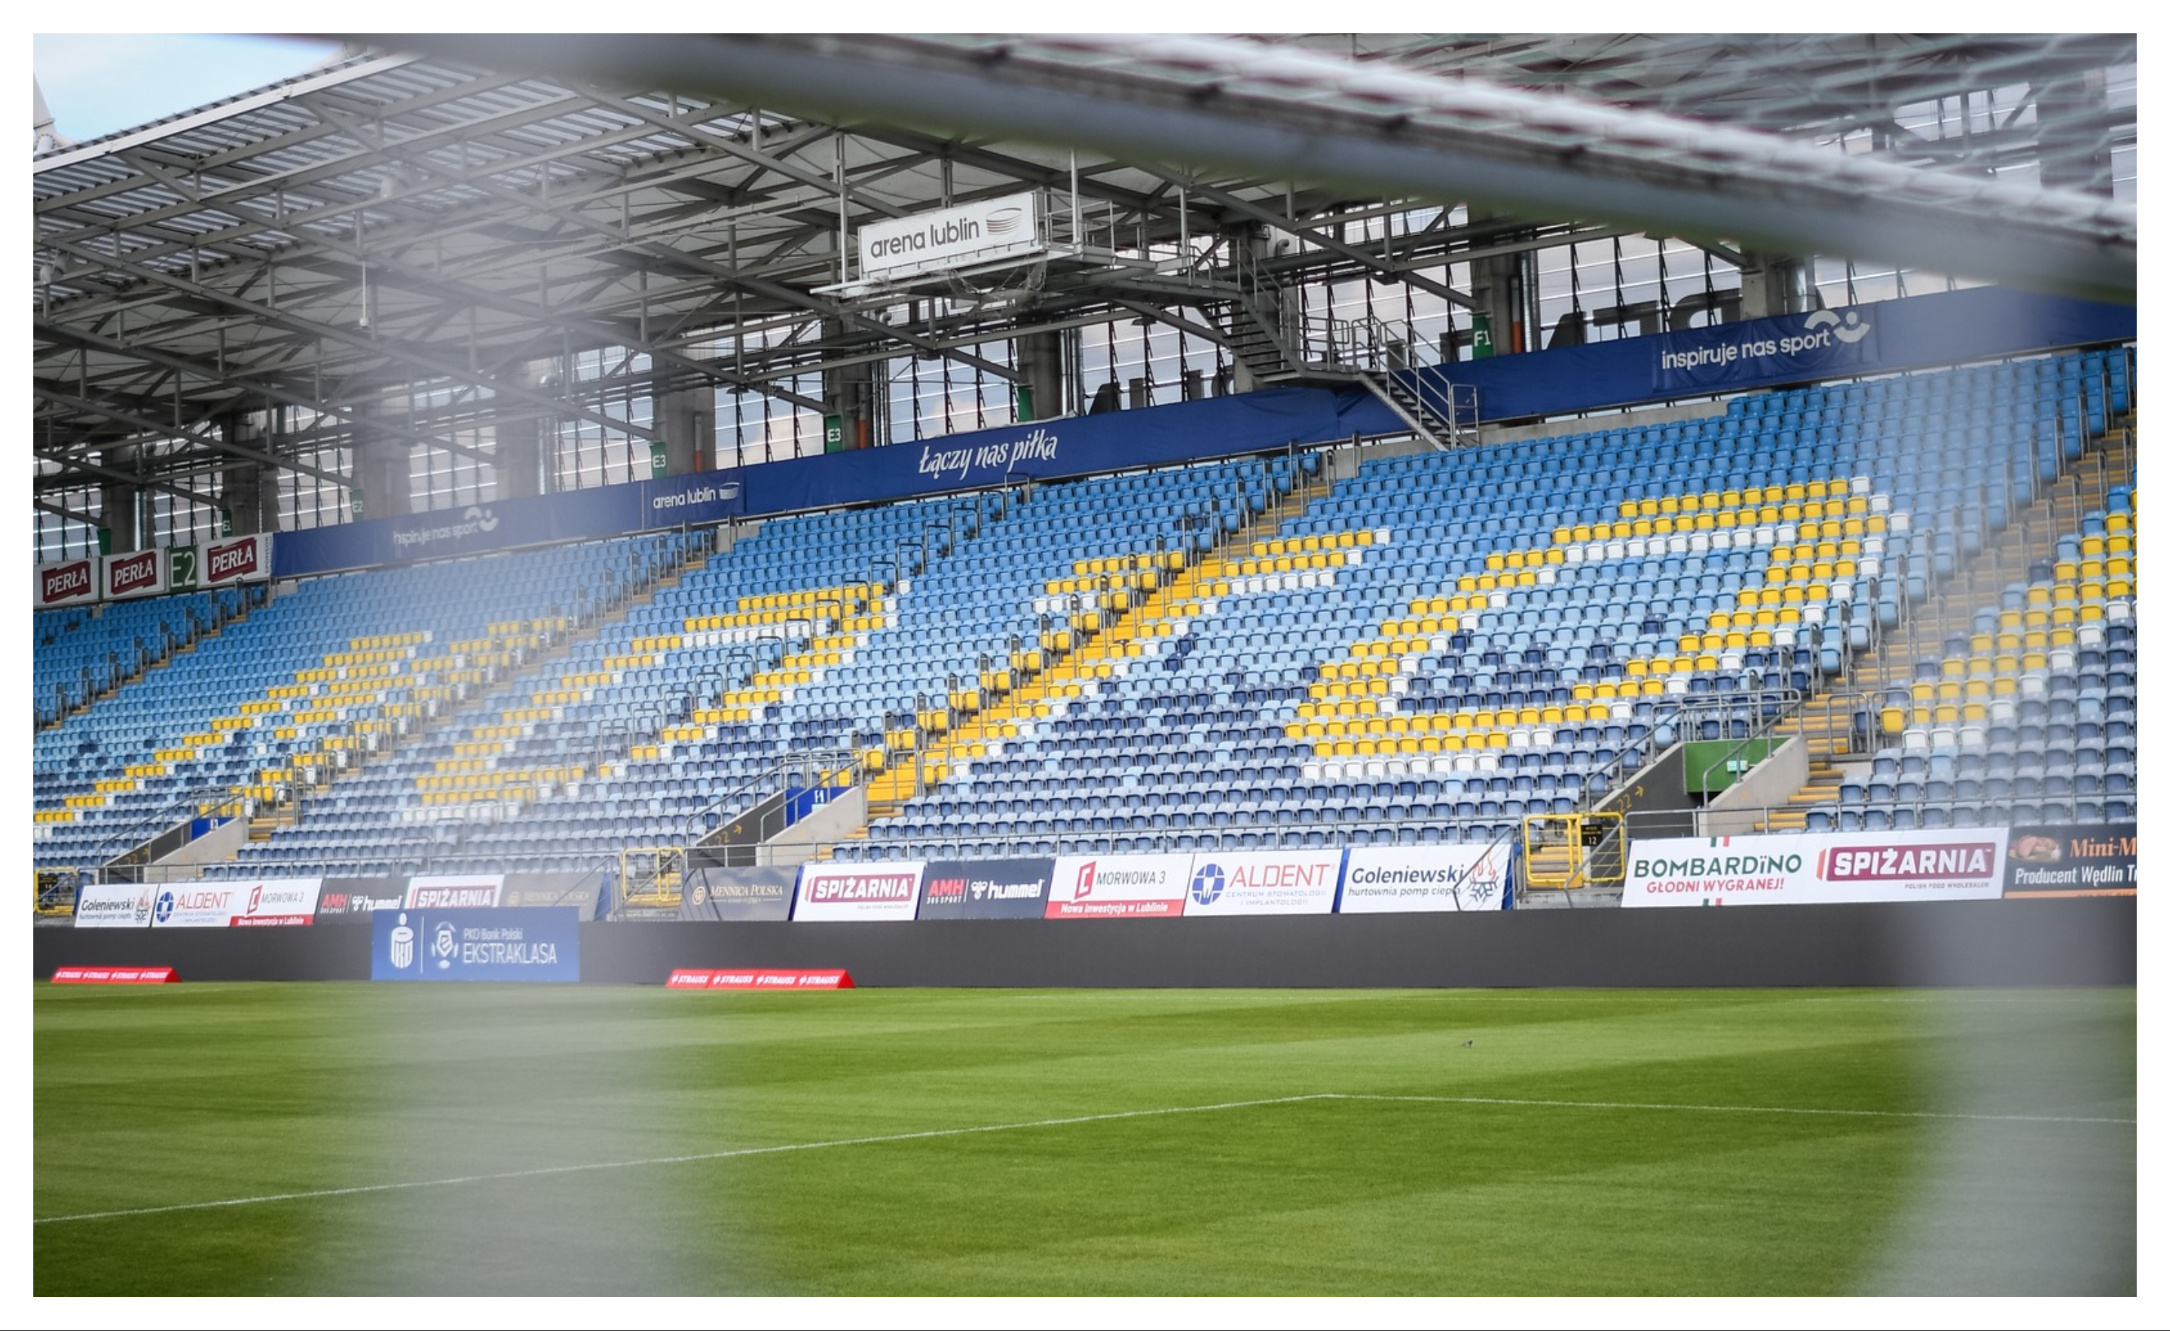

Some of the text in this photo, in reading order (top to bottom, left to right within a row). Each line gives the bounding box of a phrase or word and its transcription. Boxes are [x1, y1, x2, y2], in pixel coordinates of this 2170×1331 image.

[870, 217, 980, 258] arena lublin
[1474, 330, 1491, 347] F1
[1662, 329, 1831, 370] inspiruje nas sport
[827, 428, 841, 442] E3
[652, 454, 666, 468] E3
[918, 429, 1058, 481] Łączy nas piłka
[653, 487, 716, 509] arena lublin
[170, 550, 196, 588] E2
[212, 545, 254, 575] PERŁA
[46, 567, 88, 597] PERŁA
[114, 559, 154, 588] PERŁA
[1834, 848, 1986, 876] SPIŻARNIA
[1096, 871, 1166, 885] MORWOWA 3
[1229, 864, 1330, 887] ALDENT
[1352, 864, 1464, 884] Goleniewski
[2015, 867, 2077, 885] Producent
[2081, 865, 2123, 887] Wędlin
[710, 884, 783, 896] MENNICA POLSKA
[815, 877, 908, 899] SPIŻARNIA
[928, 880, 965, 896] AMH
[987, 879, 1042, 899] hummel
[1348, 886, 1397, 896] hurtownia
[1399, 888, 1429, 898] pomp
[1647, 878, 1784, 893] GŁODNI WYGRANEJ!
[175, 892, 232, 909] ALDENT
[322, 893, 348, 907] AMH
[418, 888, 491, 908] SPIŻARNIA
[1061, 904, 1083, 913] Nowa
[463, 928, 523, 940] PKO Bank Polski
[463, 943, 557, 964] EKSTRAKLASA
[678, 975, 839, 984] STRAUSS STRAUSS STRAUSS STRAUSS
